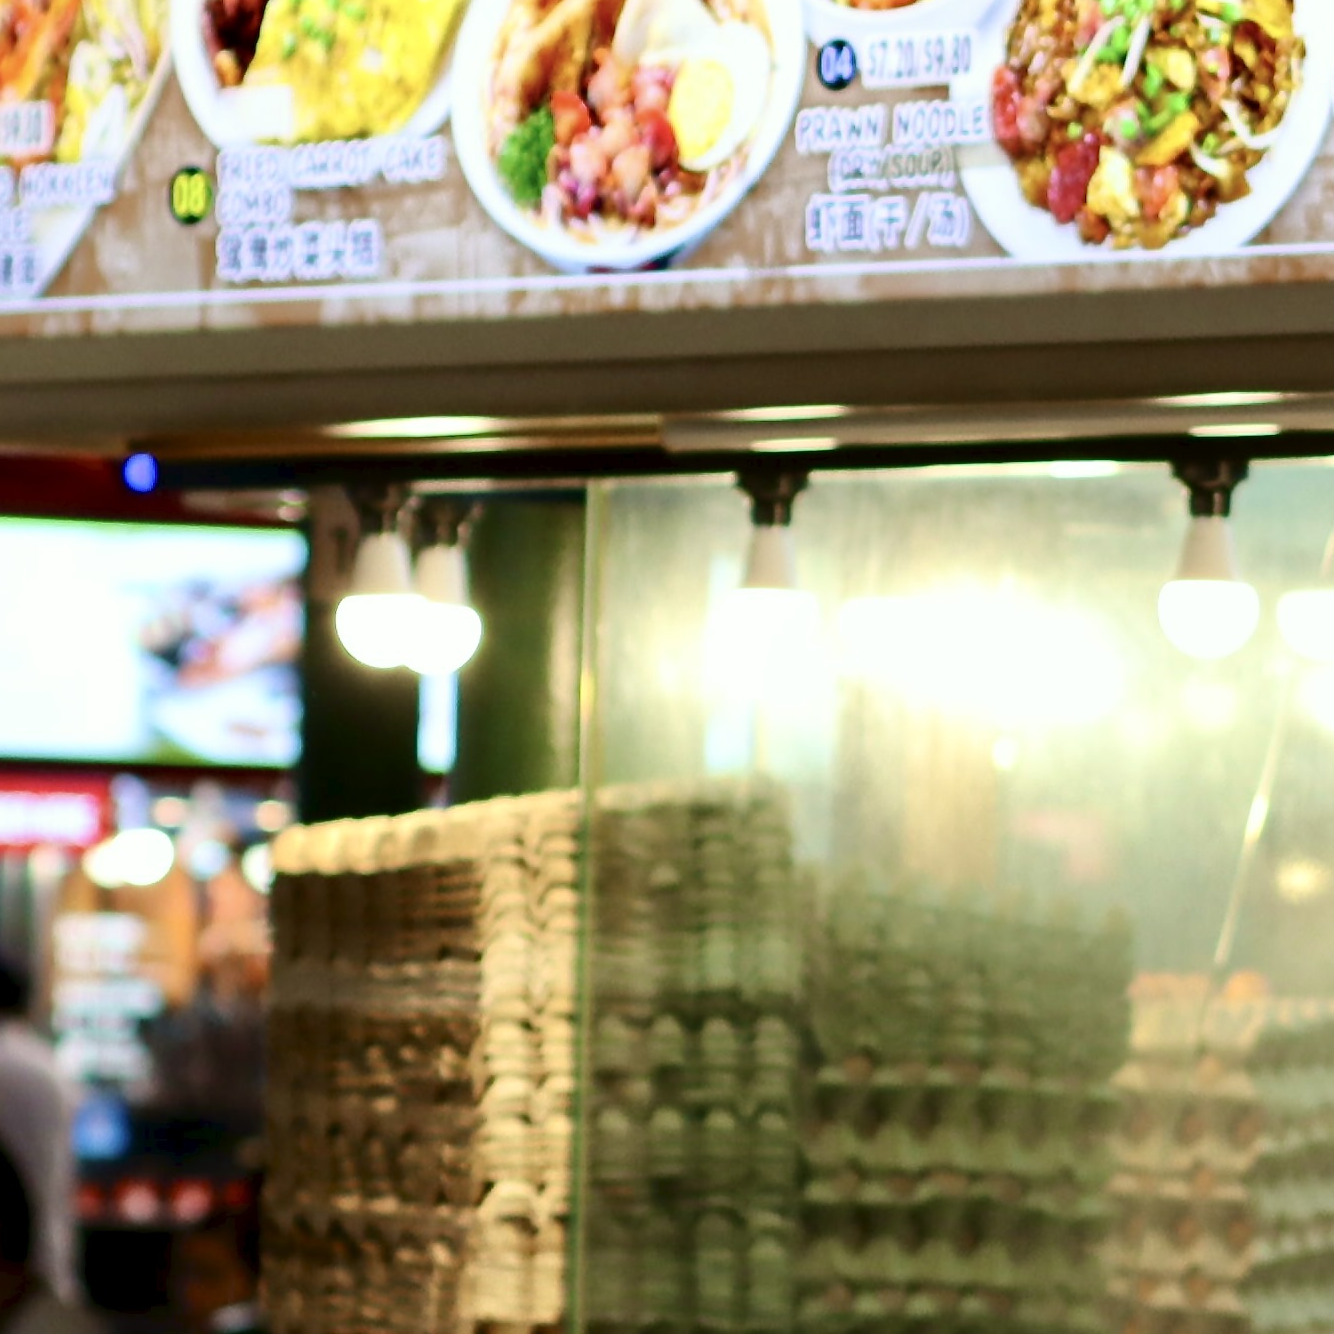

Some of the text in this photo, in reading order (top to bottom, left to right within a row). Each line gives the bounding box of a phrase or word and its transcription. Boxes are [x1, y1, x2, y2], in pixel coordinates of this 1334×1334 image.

[820, 45, 855, 84] 04
[797, 102, 987, 143] PRAWN NOODLE
[171, 171, 208, 218] 08
